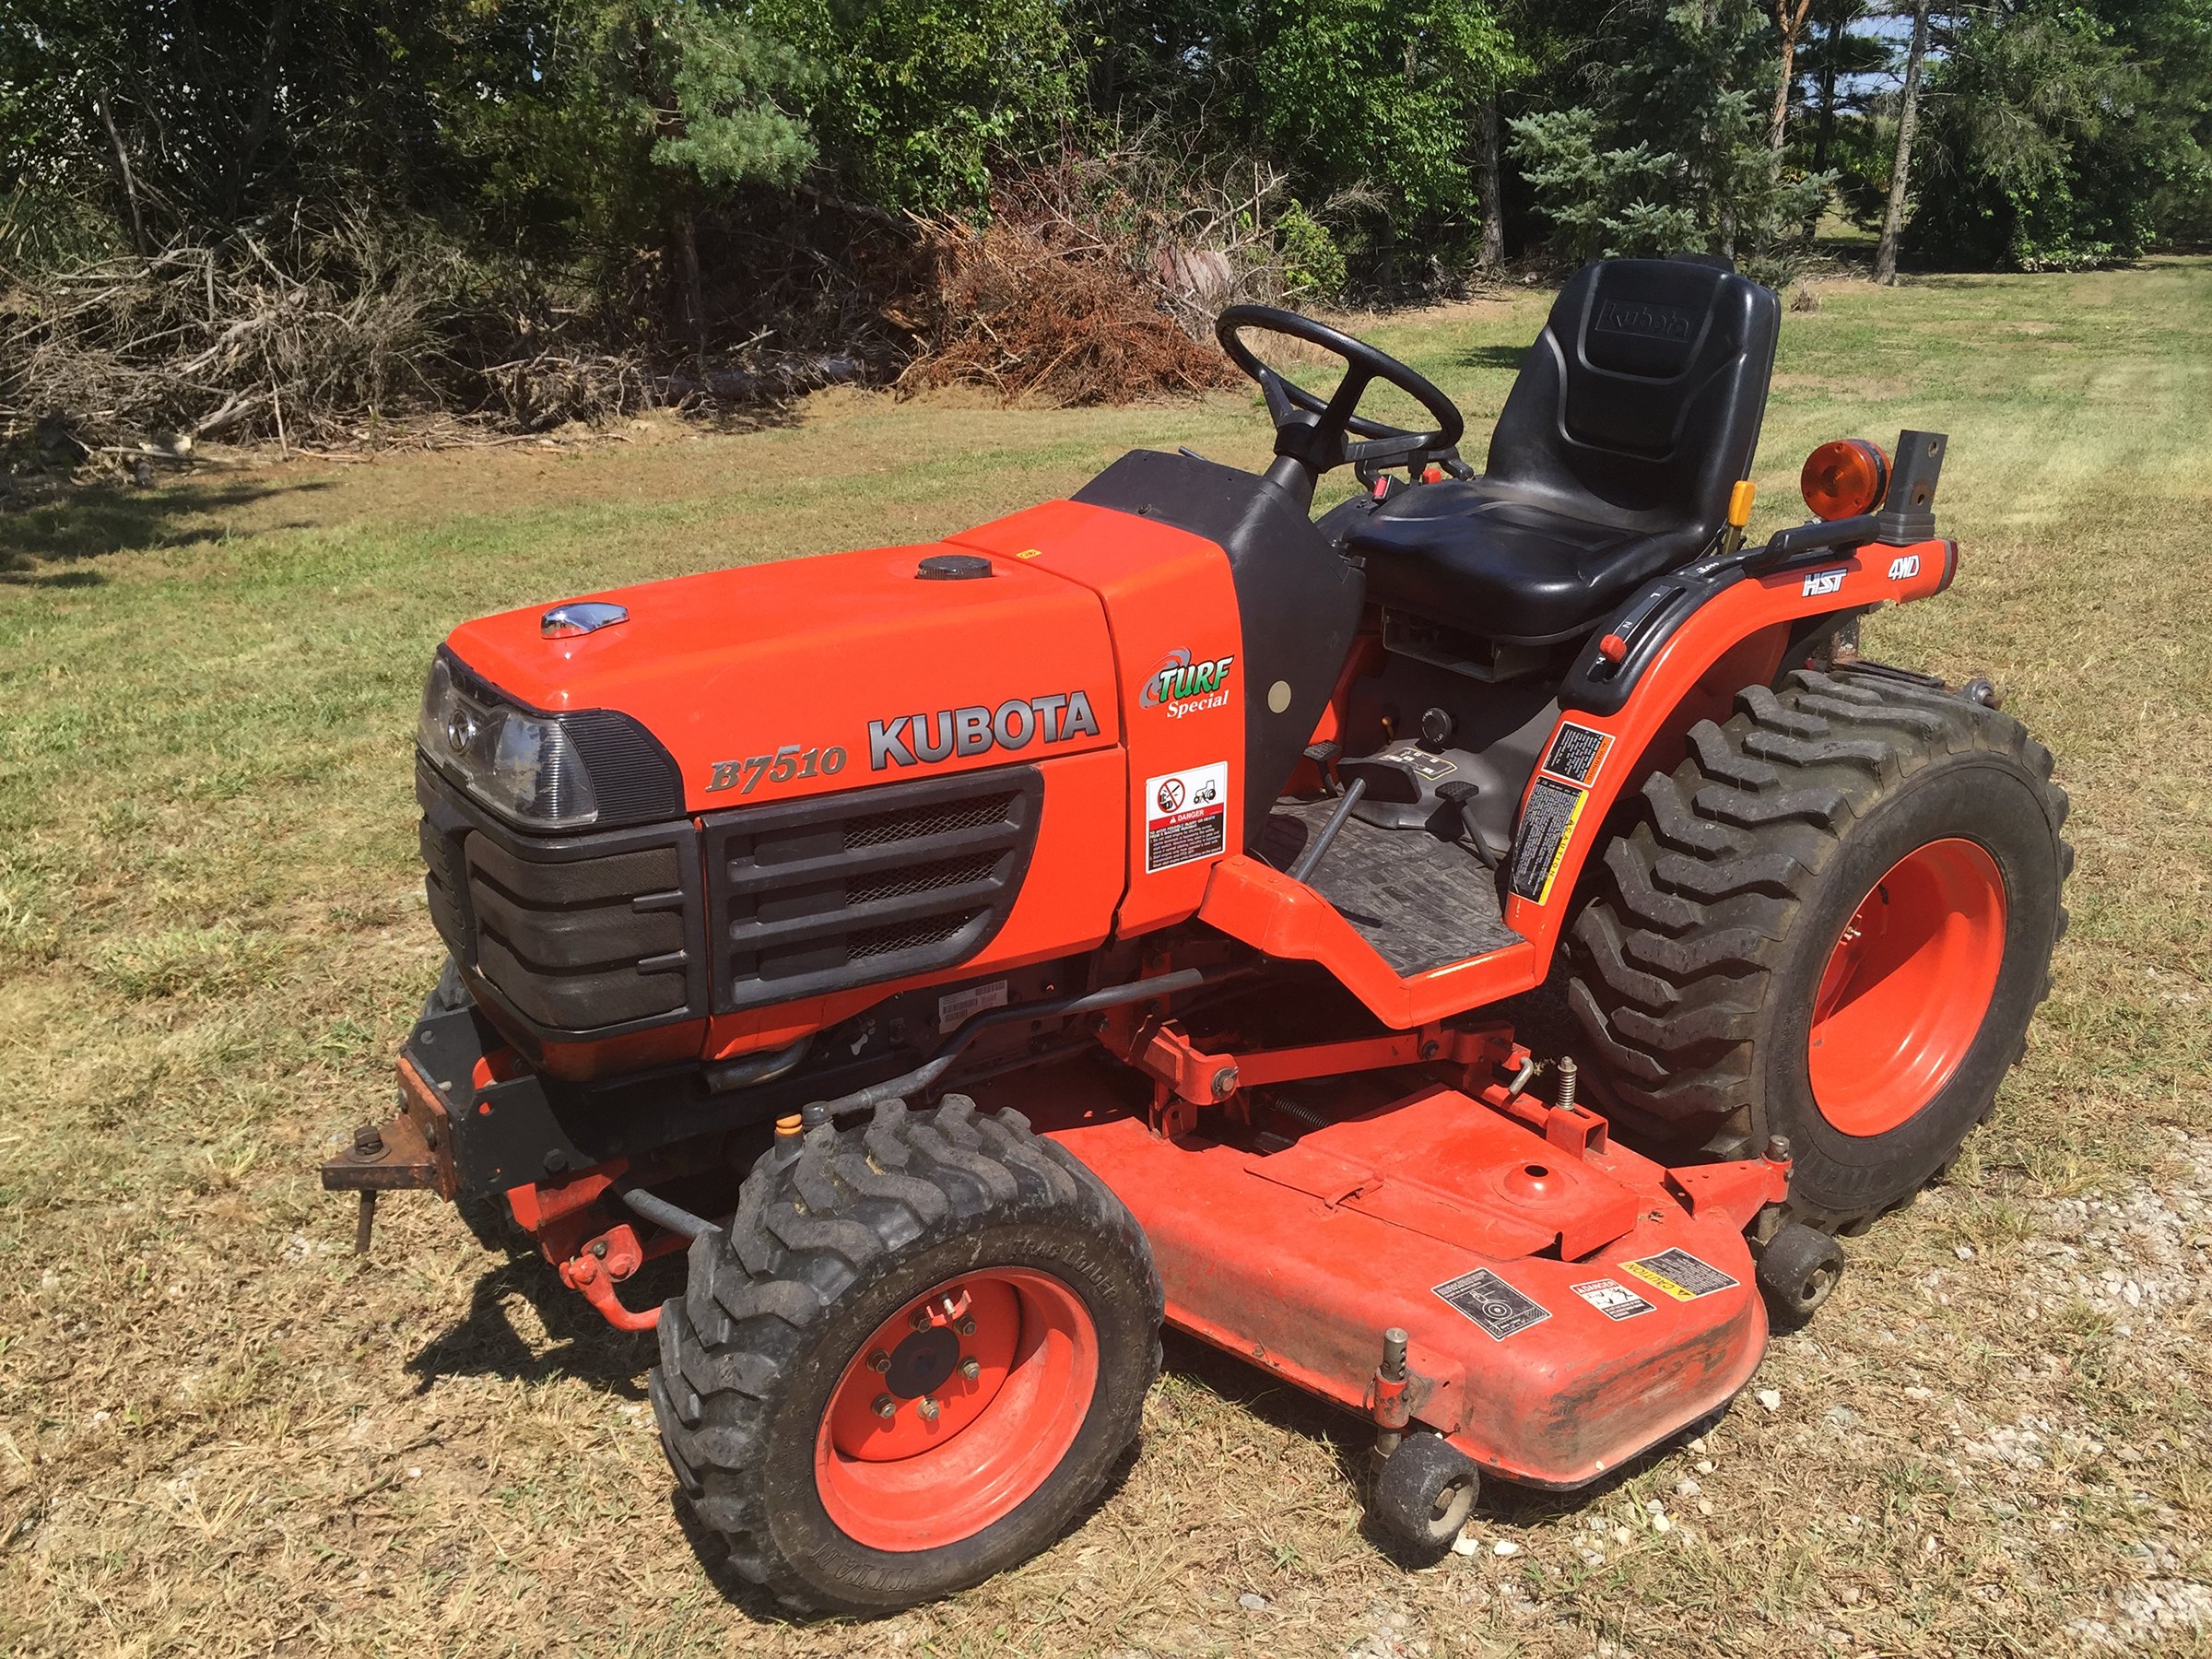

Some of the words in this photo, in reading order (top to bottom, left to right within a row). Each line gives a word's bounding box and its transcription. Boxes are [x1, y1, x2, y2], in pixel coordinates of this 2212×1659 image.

[1801, 568, 1847, 597] HST
[1888, 555, 1920, 582] 4WD
[1159, 653, 1236, 703] TURF
[1166, 689, 1230, 719] Special
[704, 744, 847, 794] B7510
[867, 689, 1100, 771] KUBOTA
[1587, 749, 1606, 782] WARNING
[1177, 809, 1205, 822] DANGER
[1549, 826, 1572, 878] CAUTION
[1583, 1278, 1618, 1292] DANGER
[1625, 1262, 1675, 1292] CAUTION
[807, 1542, 912, 1594] TITAN
